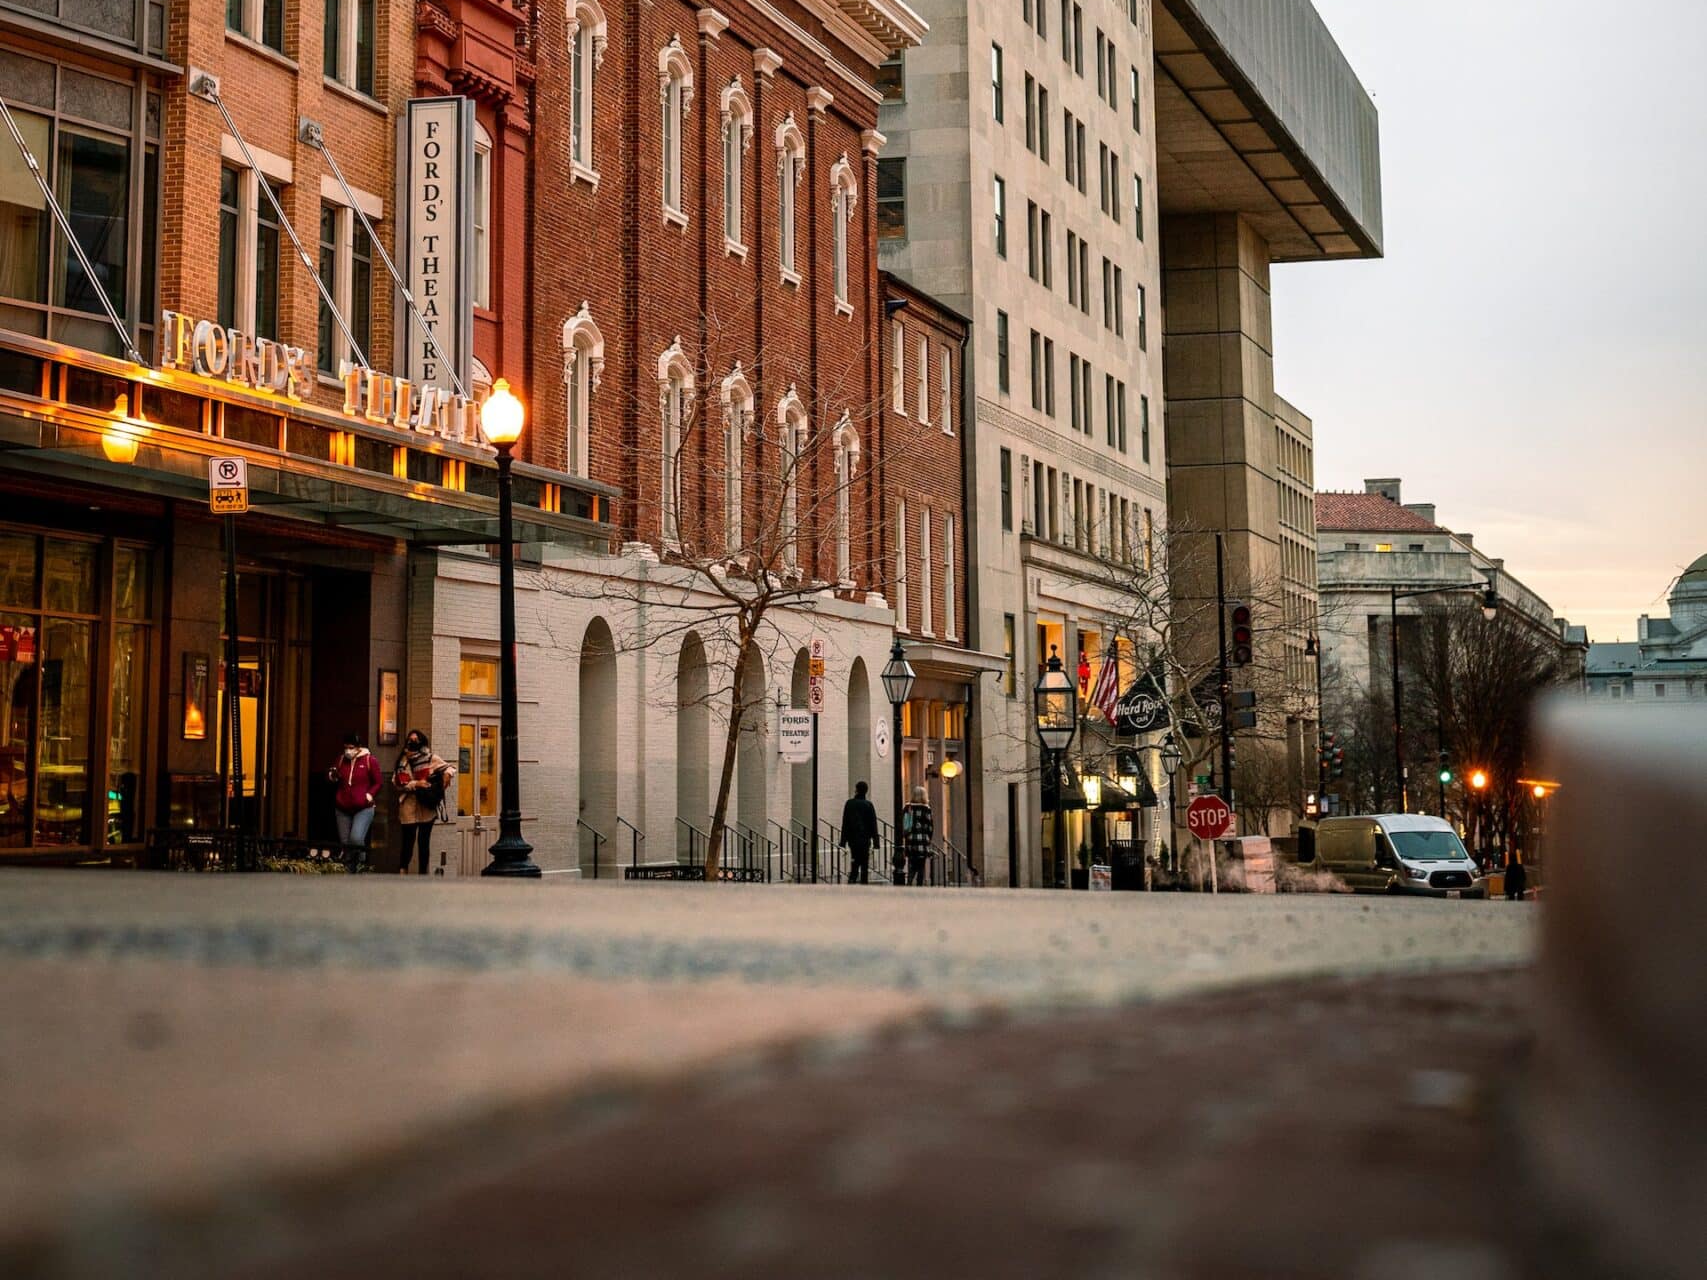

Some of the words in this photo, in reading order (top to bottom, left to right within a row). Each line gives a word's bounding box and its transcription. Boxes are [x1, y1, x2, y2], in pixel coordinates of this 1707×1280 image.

[422, 121, 443, 222] FORD'S
[422, 235, 439, 381] THEATRE
[1118, 701, 1141, 716] Hard
[1189, 808, 1227, 827] STOP
